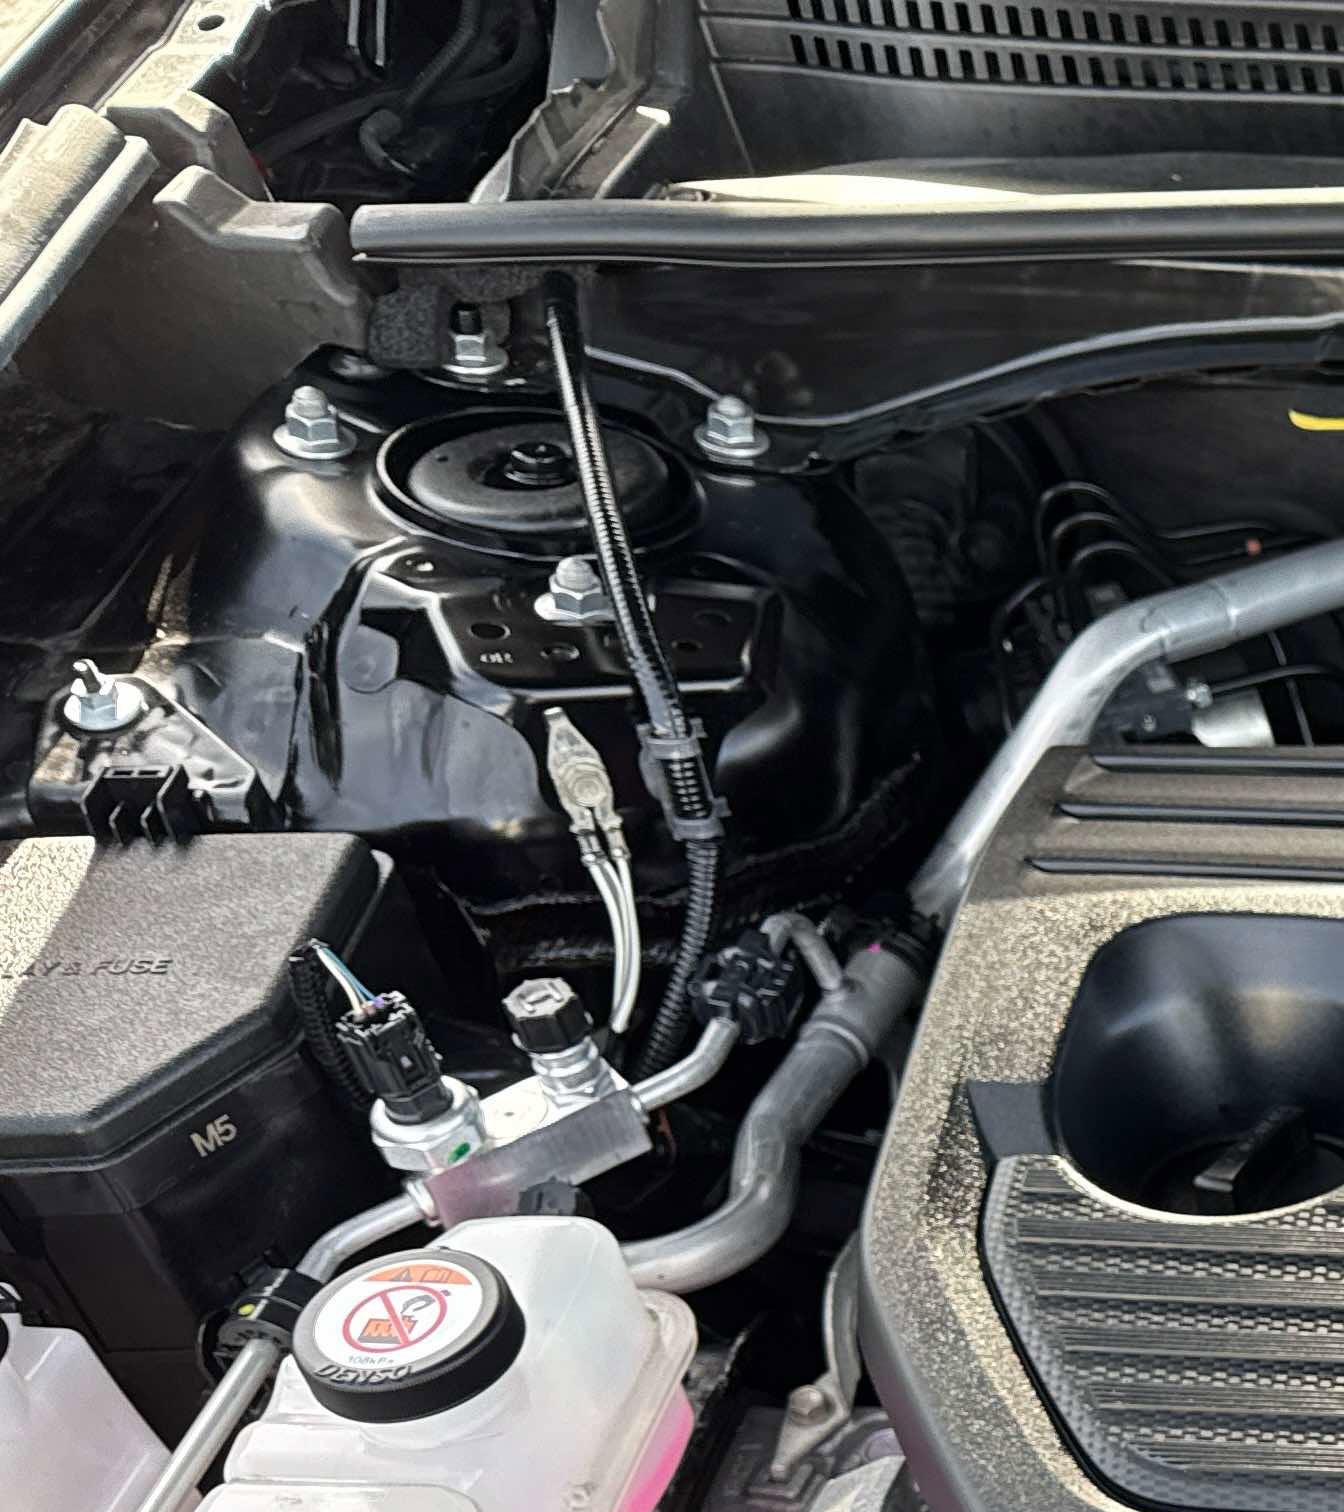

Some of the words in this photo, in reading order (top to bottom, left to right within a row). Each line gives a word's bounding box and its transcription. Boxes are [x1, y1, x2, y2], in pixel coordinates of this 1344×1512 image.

[90, 959, 174, 976] FUSE
[190, 1115, 237, 1158] M5
[312, 1363, 413, 1386] DENSO
